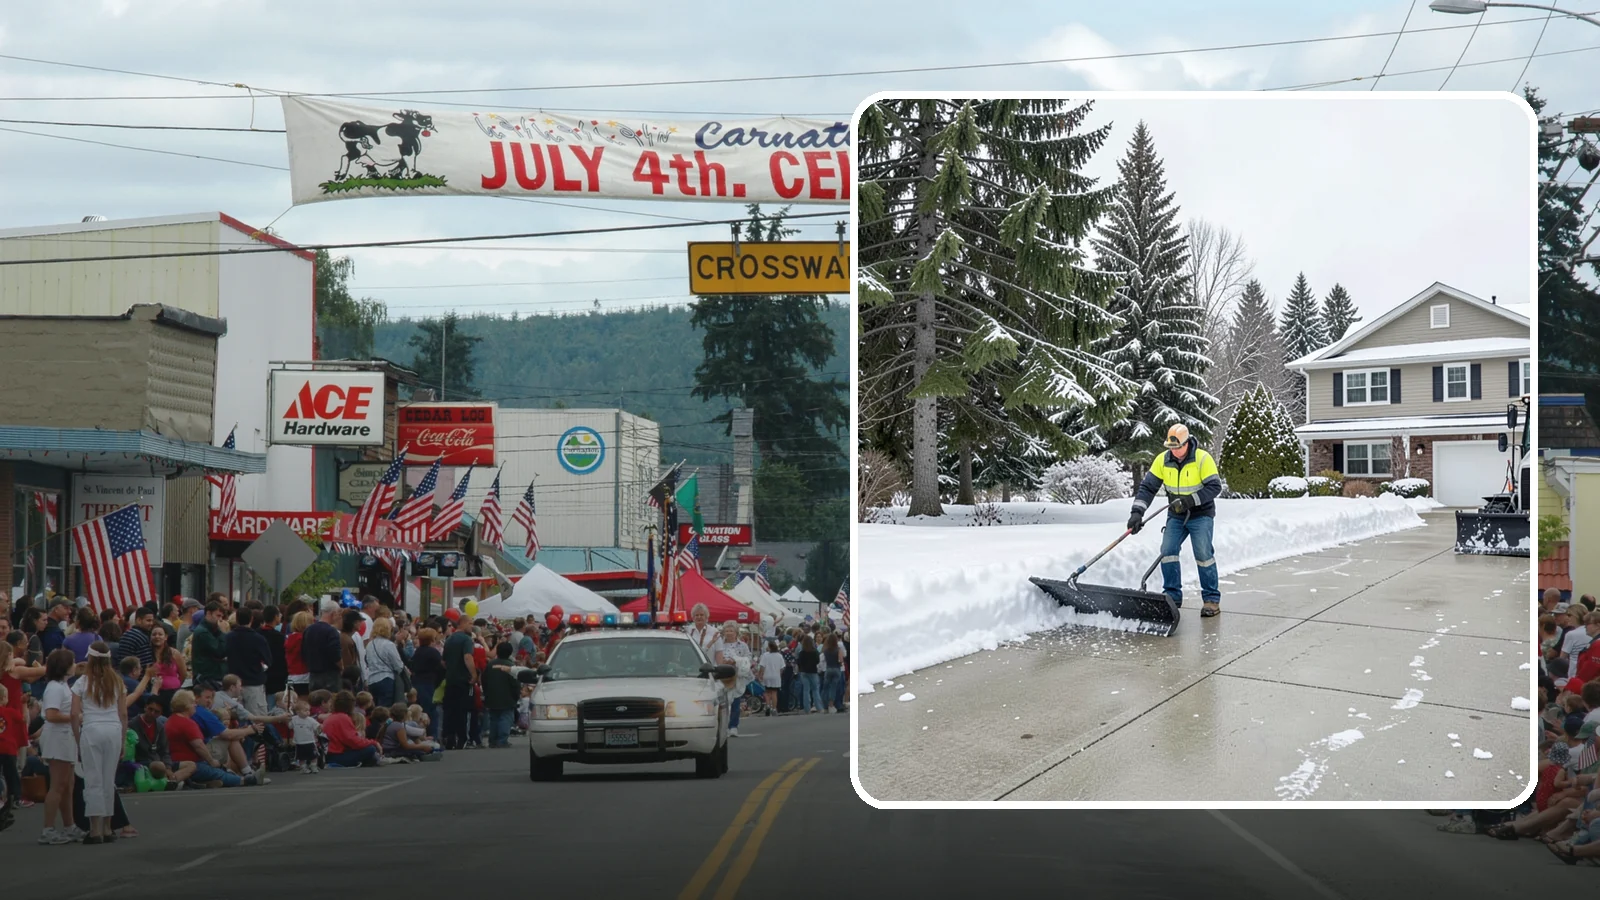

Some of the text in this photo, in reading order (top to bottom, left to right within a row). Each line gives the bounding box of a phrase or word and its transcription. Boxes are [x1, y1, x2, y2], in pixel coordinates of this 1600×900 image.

[695, 121, 850, 150] Carnat
[481, 141, 605, 193] JULY
[632, 150, 747, 198] 4th.
[697, 254, 850, 280] CROSSWA
[283, 380, 373, 420] ACE
[406, 409, 485, 421] CEDAR LOG
[283, 421, 371, 436] Hardware
[353, 467, 387, 480] Simpl
[83, 484, 155, 495] St. Vincent de Paul
[81, 503, 153, 522] THT
[212, 516, 330, 535] HARDARE
[688, 526, 741, 535] CRNATION
